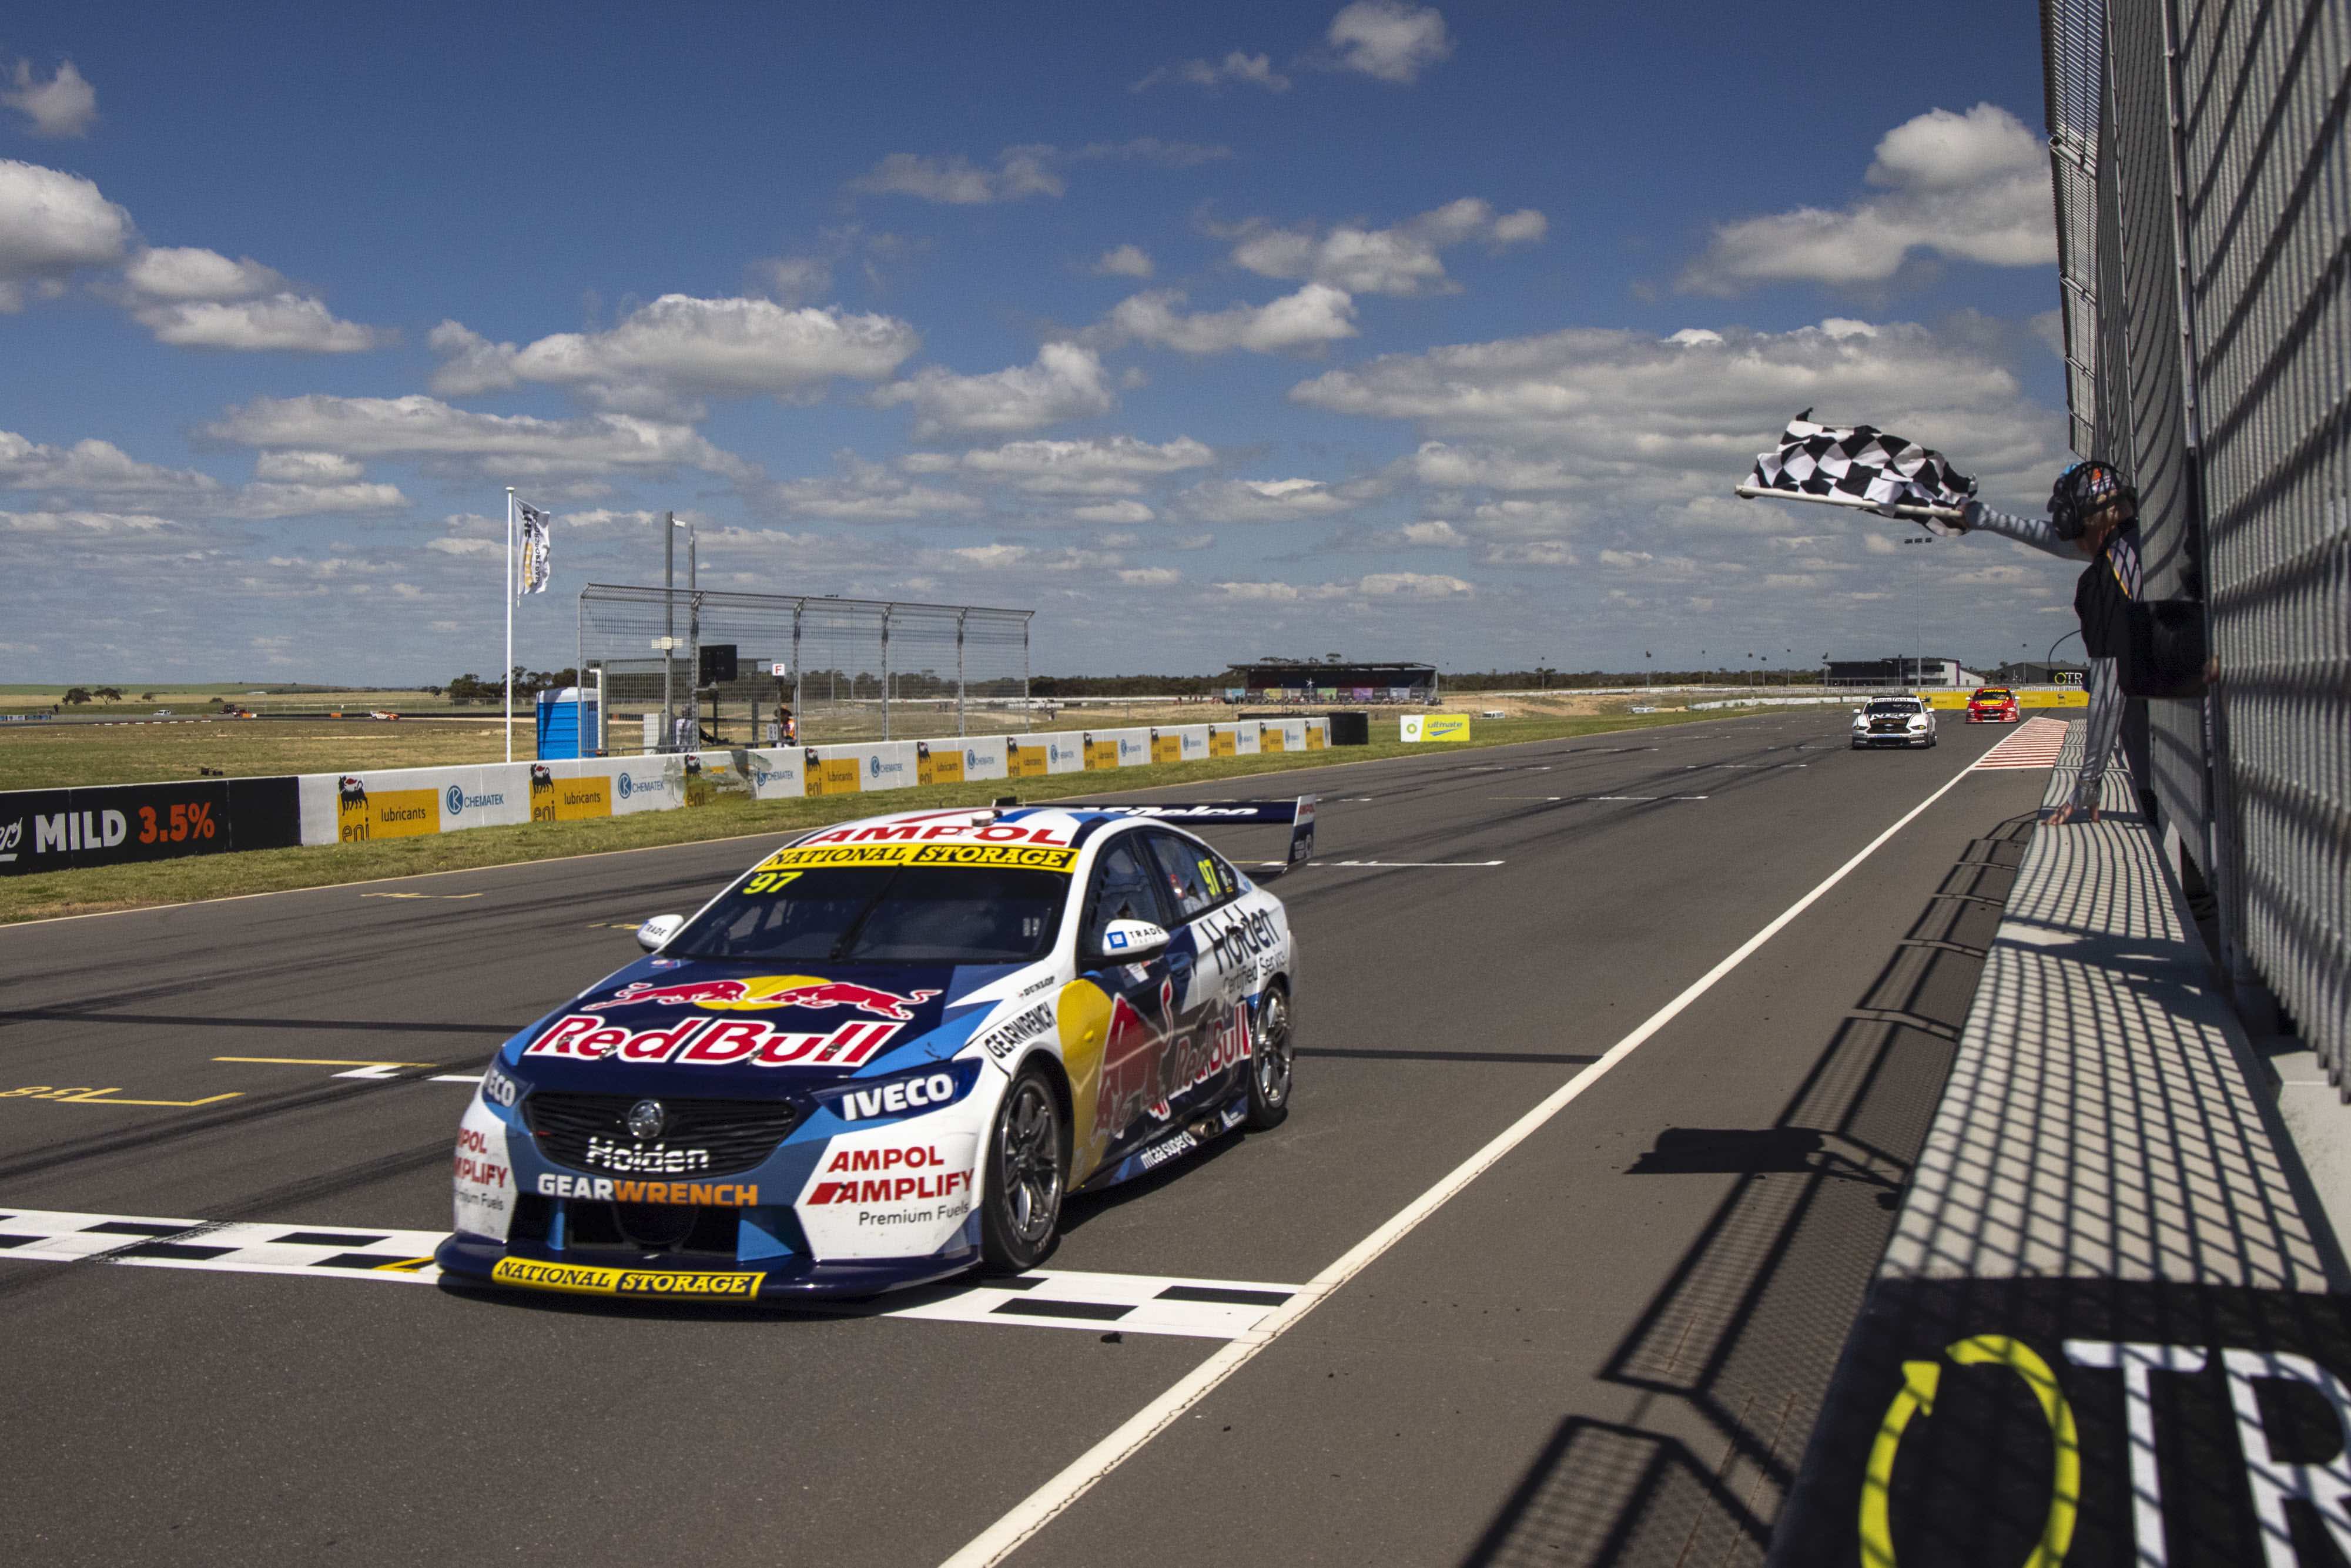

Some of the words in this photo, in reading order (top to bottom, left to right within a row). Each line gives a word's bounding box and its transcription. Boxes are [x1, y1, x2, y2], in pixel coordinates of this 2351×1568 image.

[775, 665, 782, 674] F
[2054, 672, 2083, 685] OTR
[564, 791, 601, 805] lubricants
[632, 780, 664, 793] CHEMATEK
[807, 778, 822, 796] eni
[464, 793, 504, 809] CHEMATEK
[533, 801, 555, 822] eni
[35, 810, 126, 853] MILD
[139, 802, 215, 844] 3.5%
[381, 807, 426, 822] lubricants
[342, 817, 370, 842] eni
[804, 826, 1067, 847] AMPOL
[765, 847, 907, 866] NATIONAL
[917, 845, 1070, 868] STORAGE
[742, 872, 803, 894] 97
[1197, 859, 1221, 897] 97
[1129, 927, 1162, 939] TRADE
[1199, 904, 1280, 975] Holden
[1023, 975, 1055, 996] DUNLOP
[523, 1014, 711, 1063] Red
[676, 1017, 906, 1067] Bull
[984, 1001, 1057, 1058] GEARWRENCH
[487, 1068, 516, 1108] ECO
[842, 1074, 953, 1121] IVECO
[458, 1128, 487, 1154] POL
[586, 1135, 709, 1173] Holden
[454, 1156, 508, 1188] MPLIFY
[827, 1145, 944, 1173] AMPOL
[537, 1173, 758, 1207] GEARWRENCH
[835, 1168, 974, 1205] AMPLIFY
[859, 1210, 933, 1227] Premium
[937, 1200, 969, 1221] Fuels
[497, 1261, 612, 1289] NATIONAL
[622, 1272, 750, 1293] STORAGE
